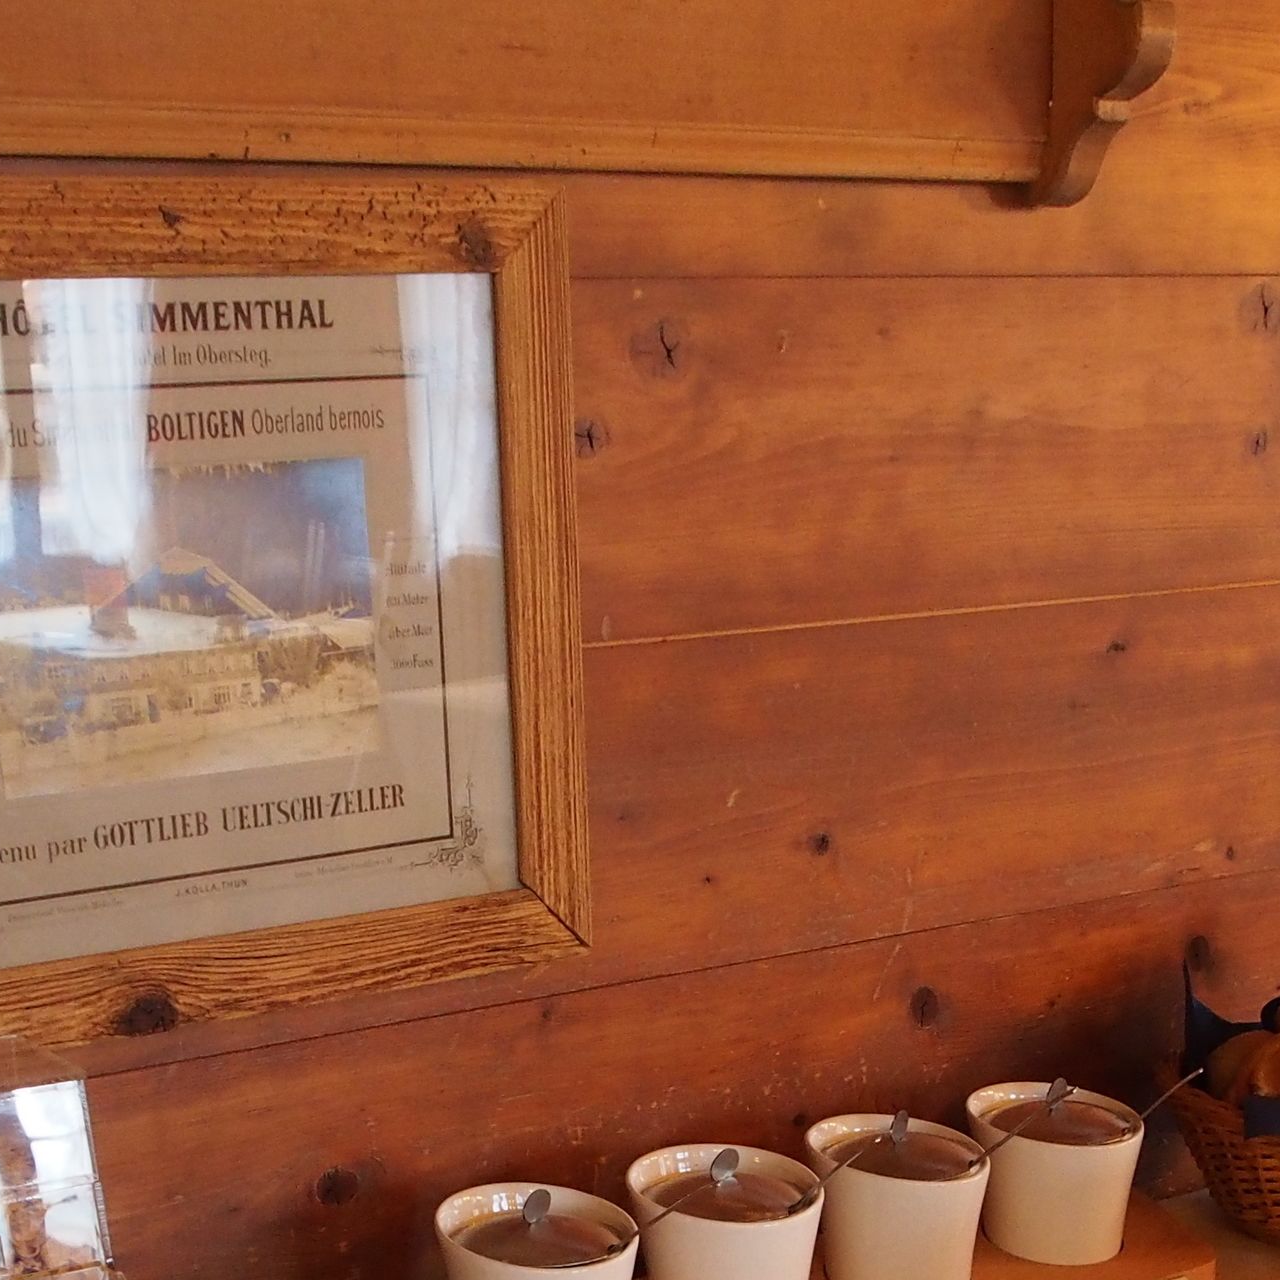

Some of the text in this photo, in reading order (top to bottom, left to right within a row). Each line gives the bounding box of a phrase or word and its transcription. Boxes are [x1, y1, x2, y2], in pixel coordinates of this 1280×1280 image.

[147, 410, 245, 443] BOLTIGEN
[251, 406, 322, 434] Oberland
[329, 403, 385, 431] bernois
[47, 836, 88, 863] par
[93, 811, 209, 850] GOTTLIEB
[222, 784, 405, 833] UELTSCHI-ZELLER
